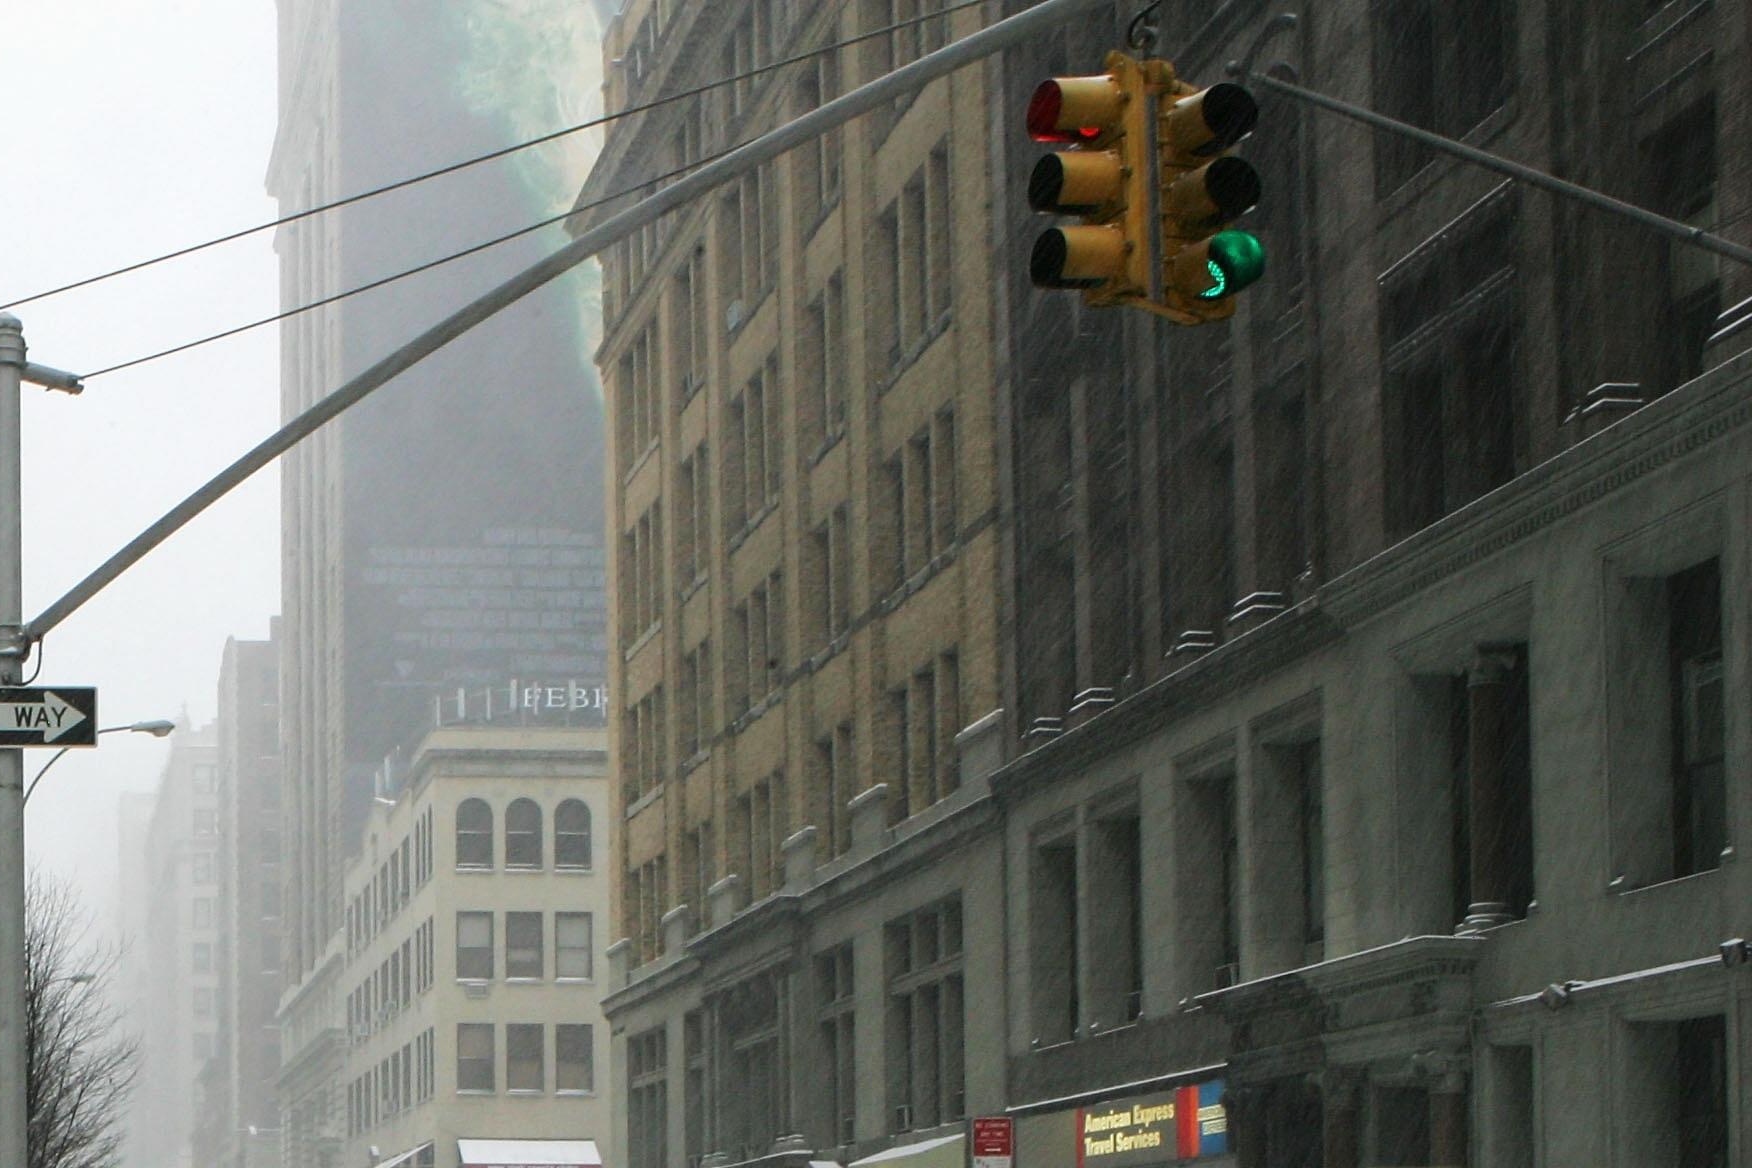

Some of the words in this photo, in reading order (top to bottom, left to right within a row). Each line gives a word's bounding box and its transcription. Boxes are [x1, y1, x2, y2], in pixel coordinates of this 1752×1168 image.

[15, 706, 68, 727] WAY
[1084, 1109, 1131, 1133] American
[1132, 1103, 1175, 1127] Express
[1084, 1133, 1114, 1157] Travel
[1115, 1128, 1160, 1152] Services
